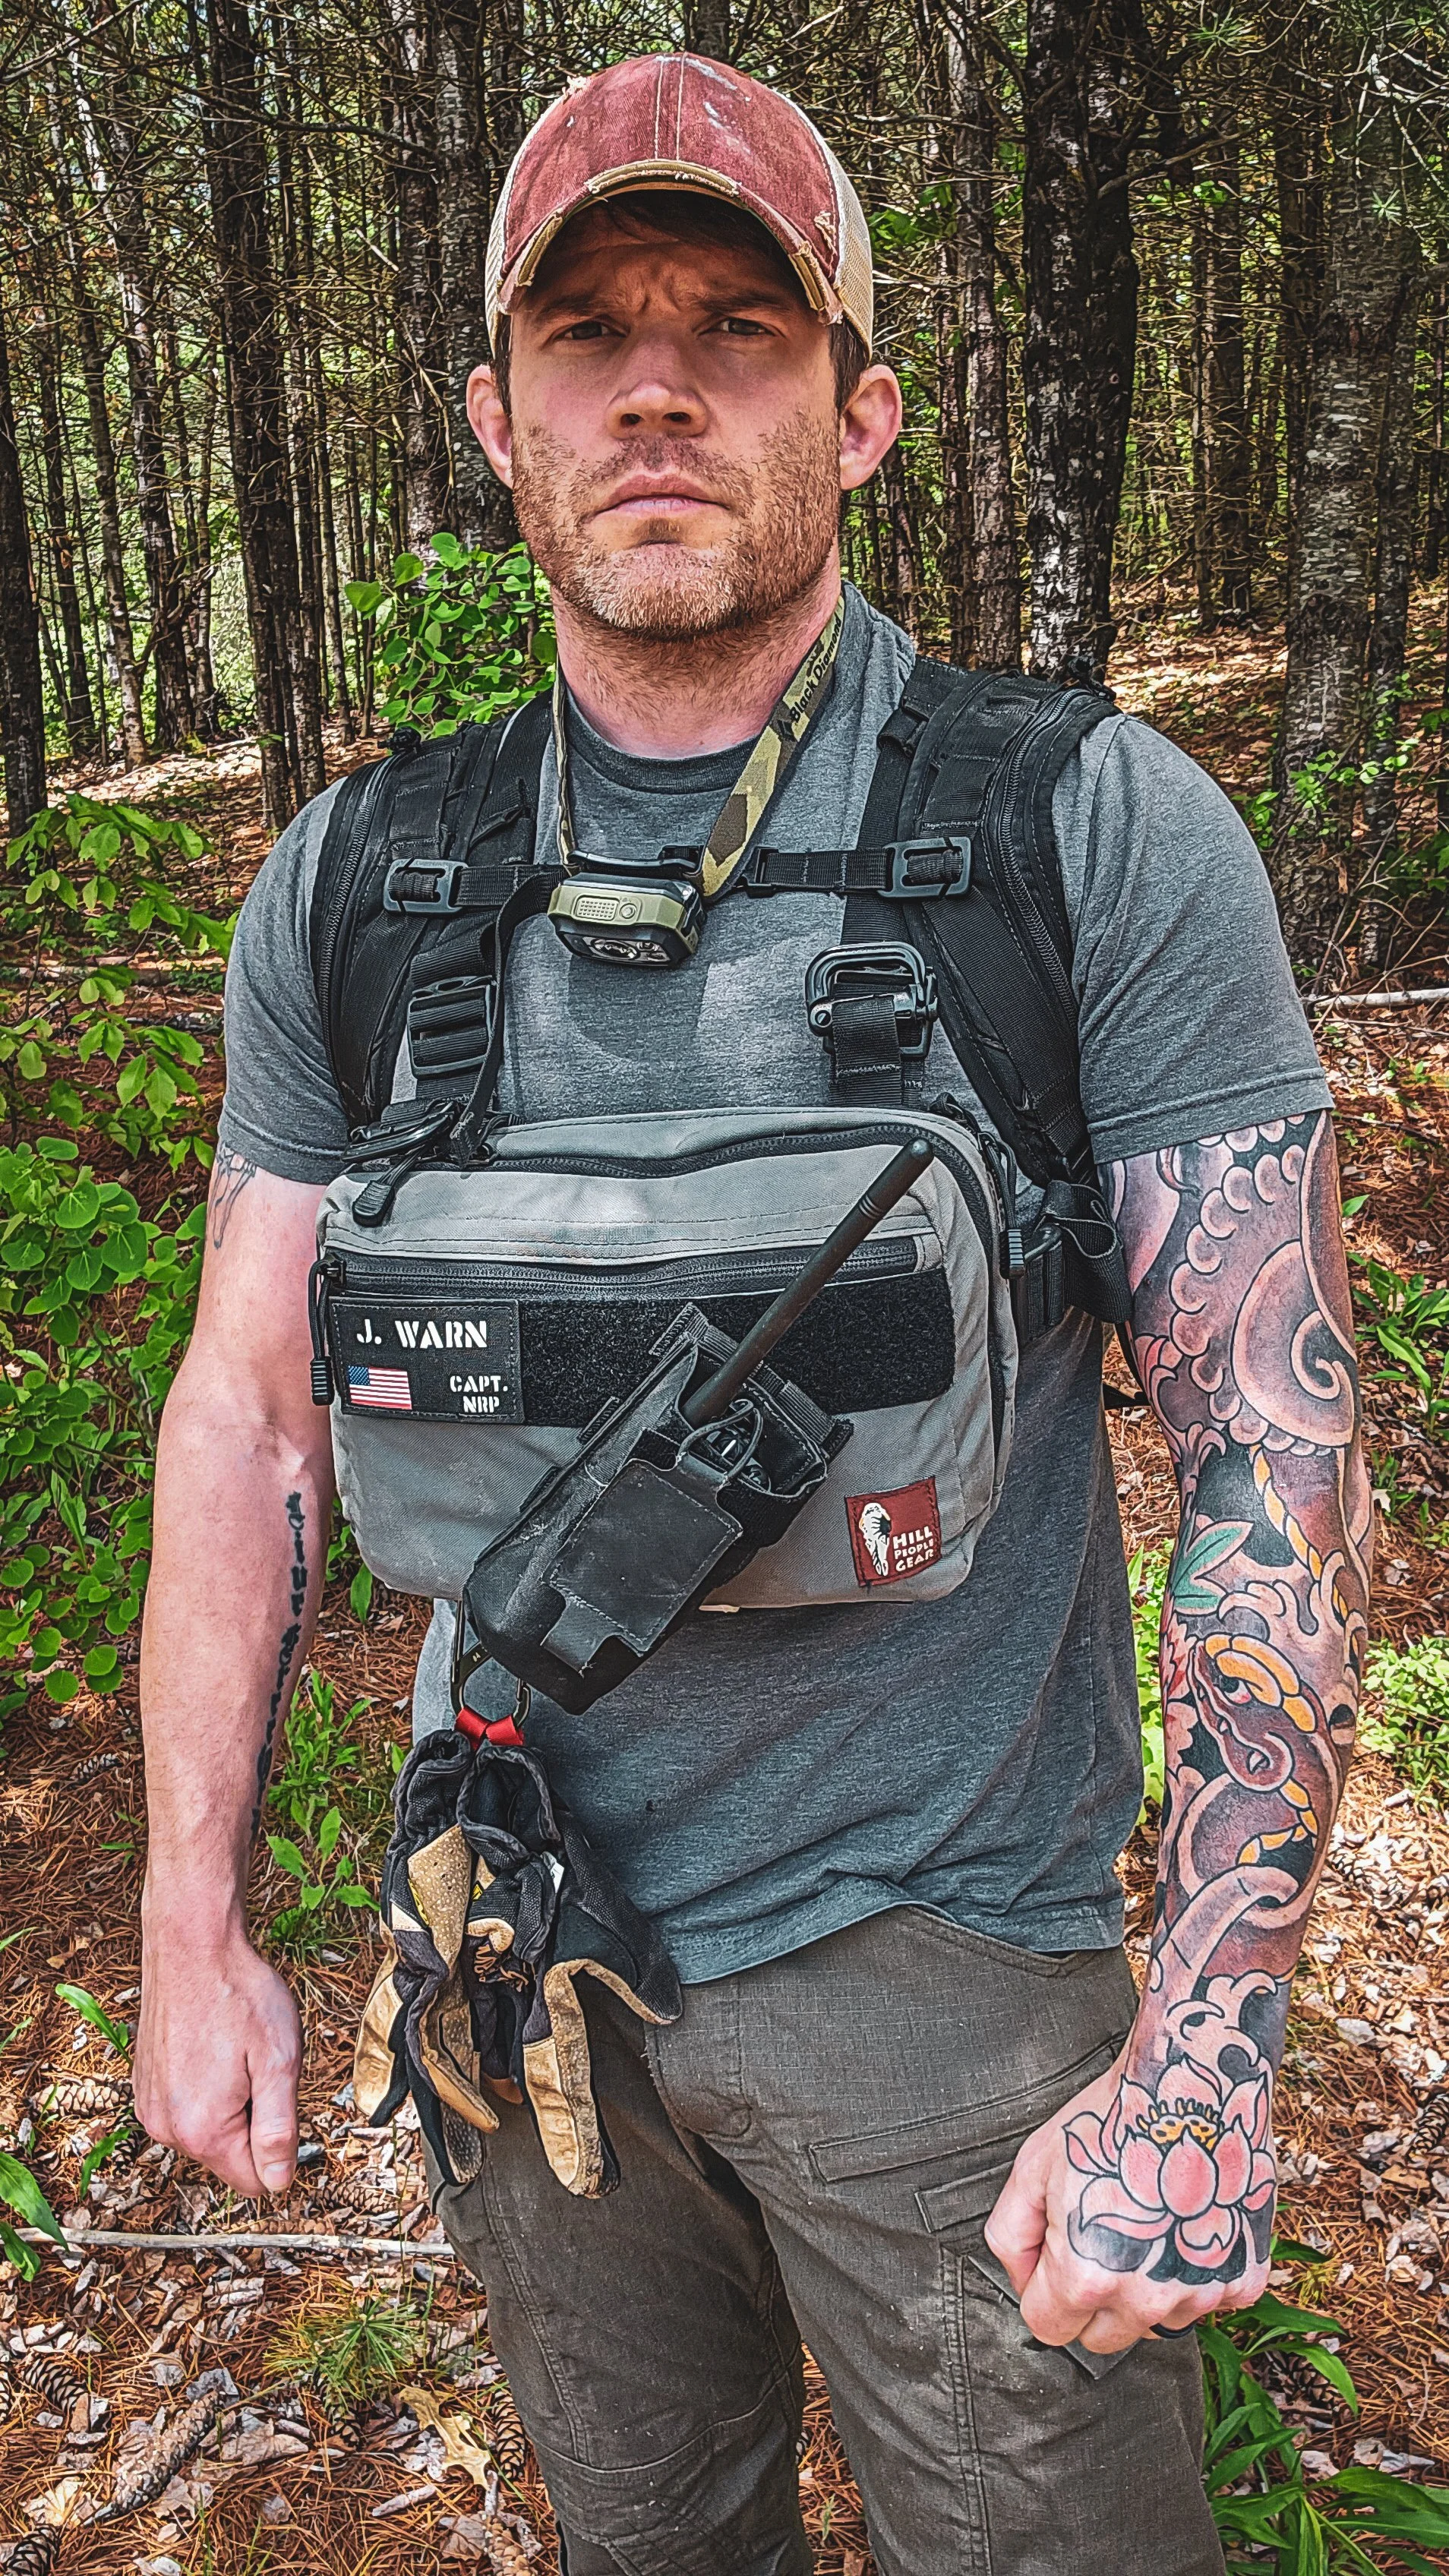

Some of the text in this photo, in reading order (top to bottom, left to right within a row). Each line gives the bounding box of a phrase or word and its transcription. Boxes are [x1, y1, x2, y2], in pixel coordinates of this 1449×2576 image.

[790, 611, 842, 723] Black Diamond
[356, 1318, 488, 1349] J. WARN
[450, 1375, 508, 1393] CAPT.
[462, 1396, 500, 1413] NRP
[892, 1526, 933, 1549] HILL
[895, 1539, 934, 1559] PEOPLE
[895, 1548, 934, 1572] GEAR
